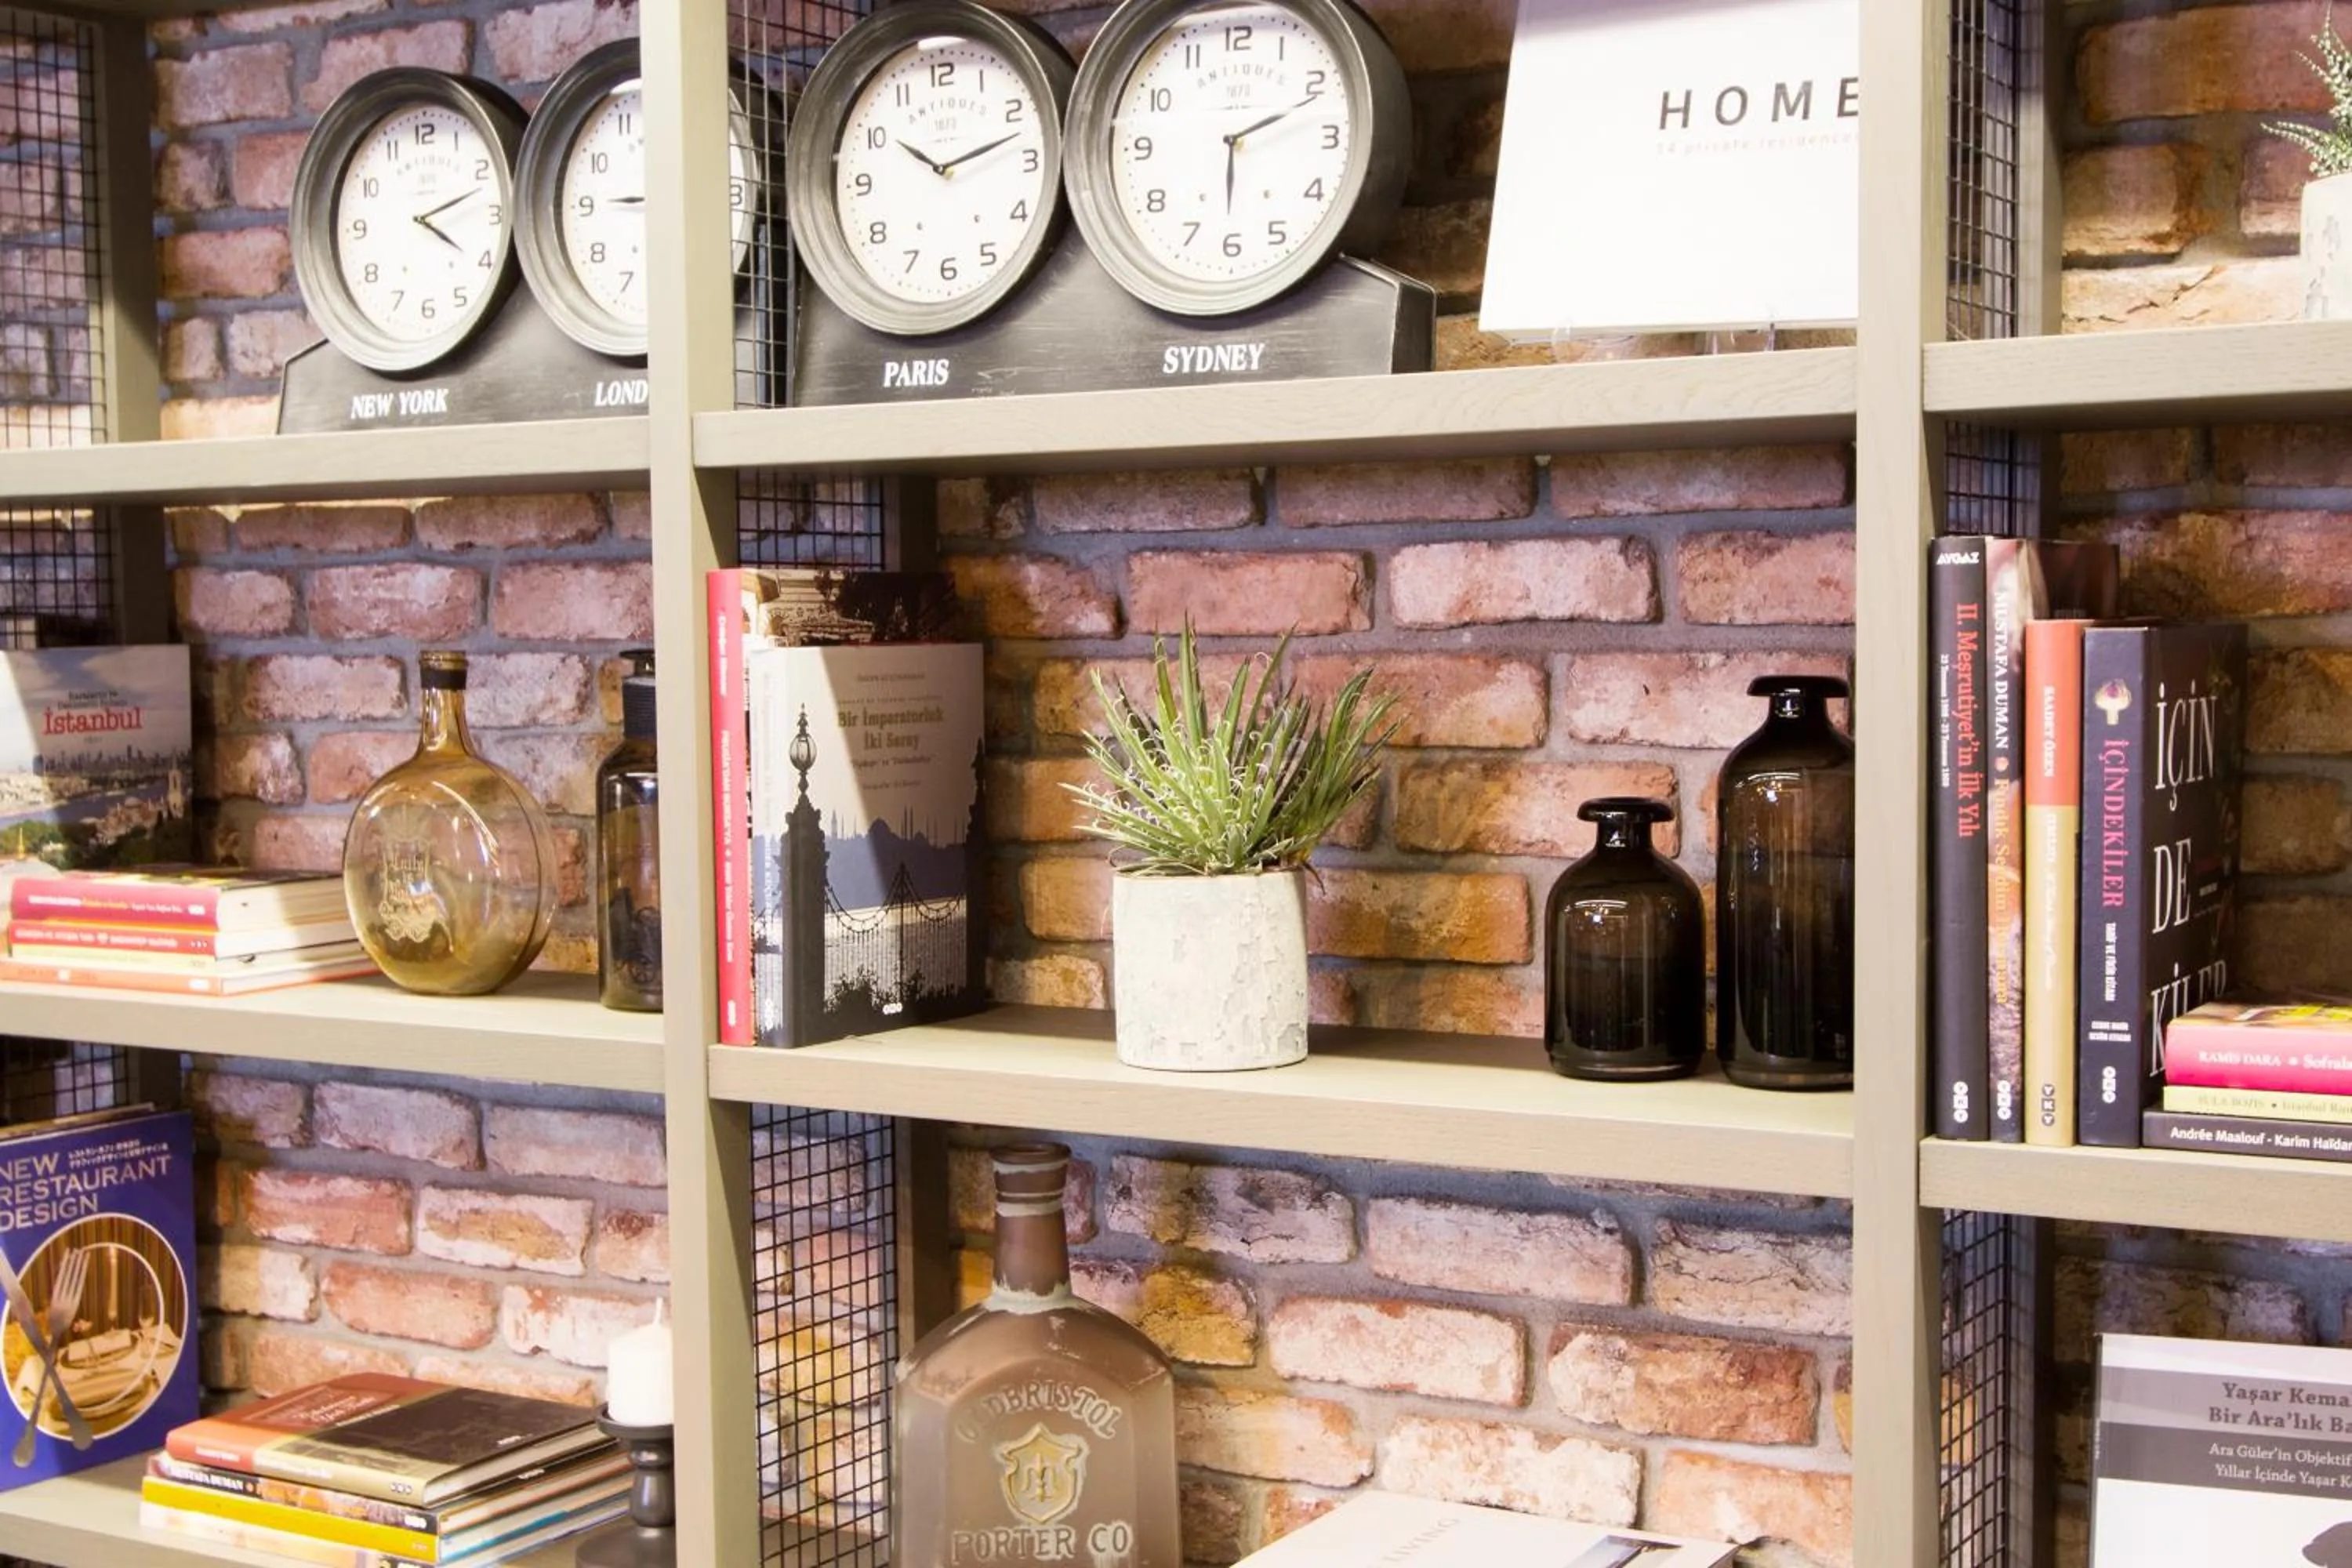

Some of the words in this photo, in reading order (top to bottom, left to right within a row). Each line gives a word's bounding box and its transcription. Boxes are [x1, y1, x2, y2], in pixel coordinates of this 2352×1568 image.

[1225, 27, 1252, 51] 12
[1185, 45, 1200, 69] 11
[931, 62, 954, 87] 12
[1306, 71, 1325, 95] 2
[897, 83, 909, 107] 11
[1150, 89, 1171, 111] 10
[1659, 77, 1859, 130] HOME
[1006, 99, 1022, 122] 2
[415, 124, 434, 144] 12
[619, 114, 630, 135] 11
[868, 126, 886, 149] 10
[1134, 137, 1152, 160] 9
[1323, 125, 1339, 149] 3
[387, 140, 398, 161] 11
[1023, 150, 1038, 172] 3
[476, 159, 488, 180] 2
[592, 152, 608, 173] 10
[363, 178, 379, 198] 10
[856, 173, 872, 196] 9
[1304, 178, 1324, 201] 4
[579, 196, 593, 216] 9
[1010, 200, 1028, 221] 4
[1147, 189, 1165, 212] 8
[488, 205, 502, 225] 3
[353, 220, 366, 239] 9
[869, 222, 887, 244] 8
[1183, 222, 1200, 246] 7
[1269, 221, 1287, 245] 5
[591, 243, 605, 263] 8
[981, 243, 996, 266] 5
[1223, 234, 1241, 256] 6
[478, 250, 493, 270] 4
[903, 250, 919, 274] 7
[941, 257, 957, 281] 6
[365, 263, 379, 283] 8
[620, 272, 633, 292] 7
[392, 291, 405, 312] 7
[422, 299, 434, 318] 6
[454, 287, 467, 307] 5
[1163, 344, 1264, 374] SYDNEY
[884, 359, 949, 387] PARIS
[351, 394, 392, 419] NEW
[398, 389, 449, 415] YORK
[1956, 602, 1978, 626] II.
[1994, 681, 2009, 750] DUMAN
[2154, 681, 2218, 811] İÇİN
[1957, 771, 1983, 798] İlk
[1958, 802, 1981, 837] Yılı
[2152, 839, 2192, 934] DE
[2171, 1127, 2212, 1141] Andrée
[2216, 1131, 2266, 1144] Maalouf
[2275, 1135, 2309, 1148] Karim
[0, 1152, 60, 1181] NEW
[0, 1154, 171, 1206] RESTAURANT
[0, 1193, 97, 1232] DESIGN
[2223, 1381, 2282, 1405] Yaşar
[2289, 1388, 2352, 1407] Kema
[2209, 1406, 2241, 1424] Bir
[2209, 1443, 2234, 1456] Ara
[2237, 1445, 2291, 1462] Güler'in
[2215, 1464, 2252, 1479] Yıllar
[2256, 1465, 2296, 1485] İçinde
[2300, 1472, 2337, 1489] Yaşar
[952, 1527, 1075, 1563] PORTER
[1091, 1523, 1131, 1554] CO
